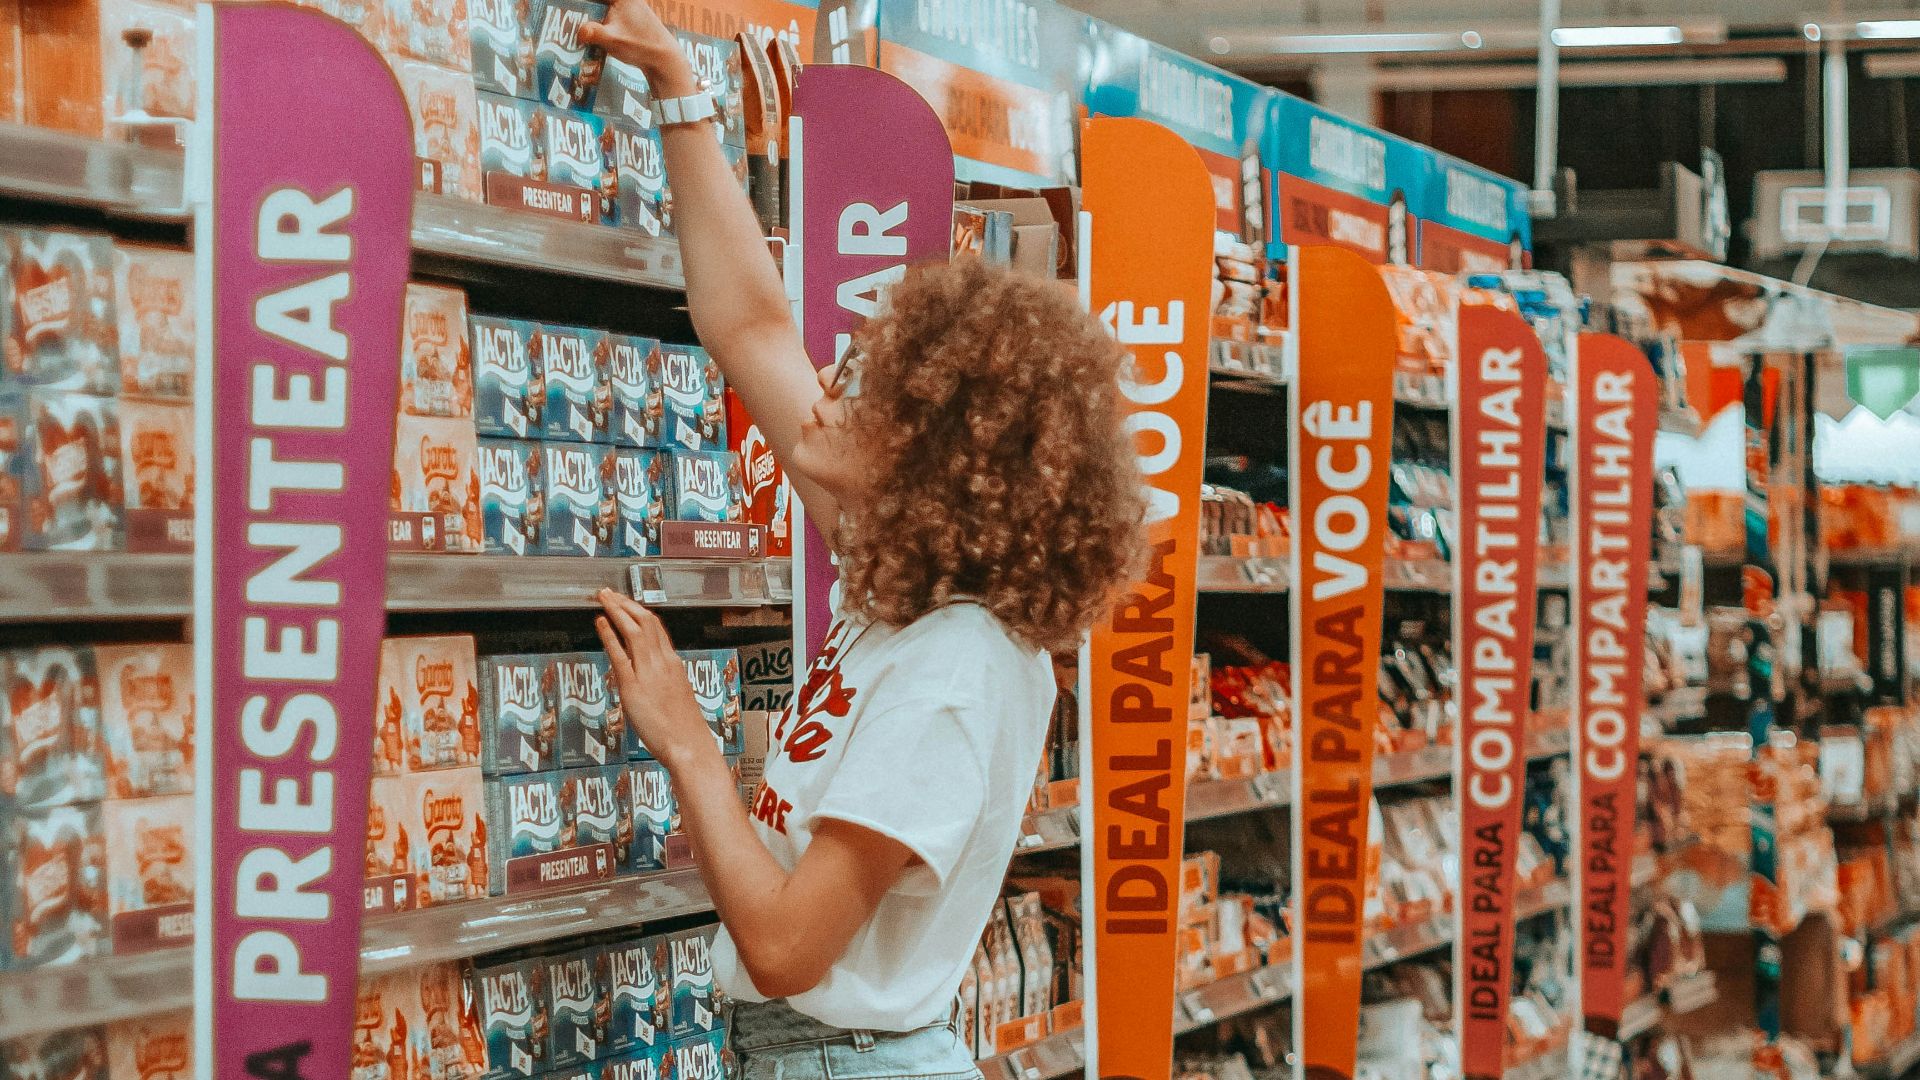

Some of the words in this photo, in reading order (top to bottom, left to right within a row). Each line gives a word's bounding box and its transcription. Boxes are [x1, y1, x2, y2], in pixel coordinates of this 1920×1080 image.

[678, 38, 724, 84] ACTA
[478, 101, 529, 156] LACTA
[547, 115, 598, 167] LACTA
[614, 130, 662, 177] LACTA
[522, 186, 573, 213] PRESENTEAR
[475, 325, 527, 378] LACTA
[541, 334, 592, 383] LACTA
[608, 343, 643, 384] ACTA
[660, 353, 702, 392] ACTA
[1100, 300, 1184, 524] VOCÊ
[478, 447, 525, 496] LACTA
[546, 448, 597, 497] LACTA
[616, 457, 646, 496] CTA
[678, 456, 726, 500] LACTA
[1302, 400, 1373, 602] VOCÊ
[694, 530, 741, 549] PRESENTEAR
[233, 186, 353, 1002] PRESENTEAR
[1469, 347, 1523, 809] COMPARTILHAR
[1585, 370, 1635, 780] COMPARTILHAR
[497, 665, 540, 716] LACTA
[557, 662, 604, 710] LACTA
[683, 660, 722, 698] ACTA
[1310, 604, 1365, 763] PARA
[509, 782, 558, 832] LACTA
[576, 776, 615, 817] ACTA
[630, 770, 669, 817] LACTA
[1105, 738, 1172, 935] IDEAL
[1589, 793, 1618, 874] PARA
[540, 856, 589, 882] PRESENTEAR
[1306, 778, 1360, 944] IDEAL
[1472, 821, 1504, 914] PARA
[1586, 882, 1617, 969] IDEAL
[549, 959, 593, 1011] LACTA
[610, 947, 654, 996] LACTA
[670, 936, 711, 985] LACTA
[1470, 923, 1501, 1021] IDEAL
[482, 971, 529, 1024] LACTA
[676, 1042, 719, 1080] LACTA
